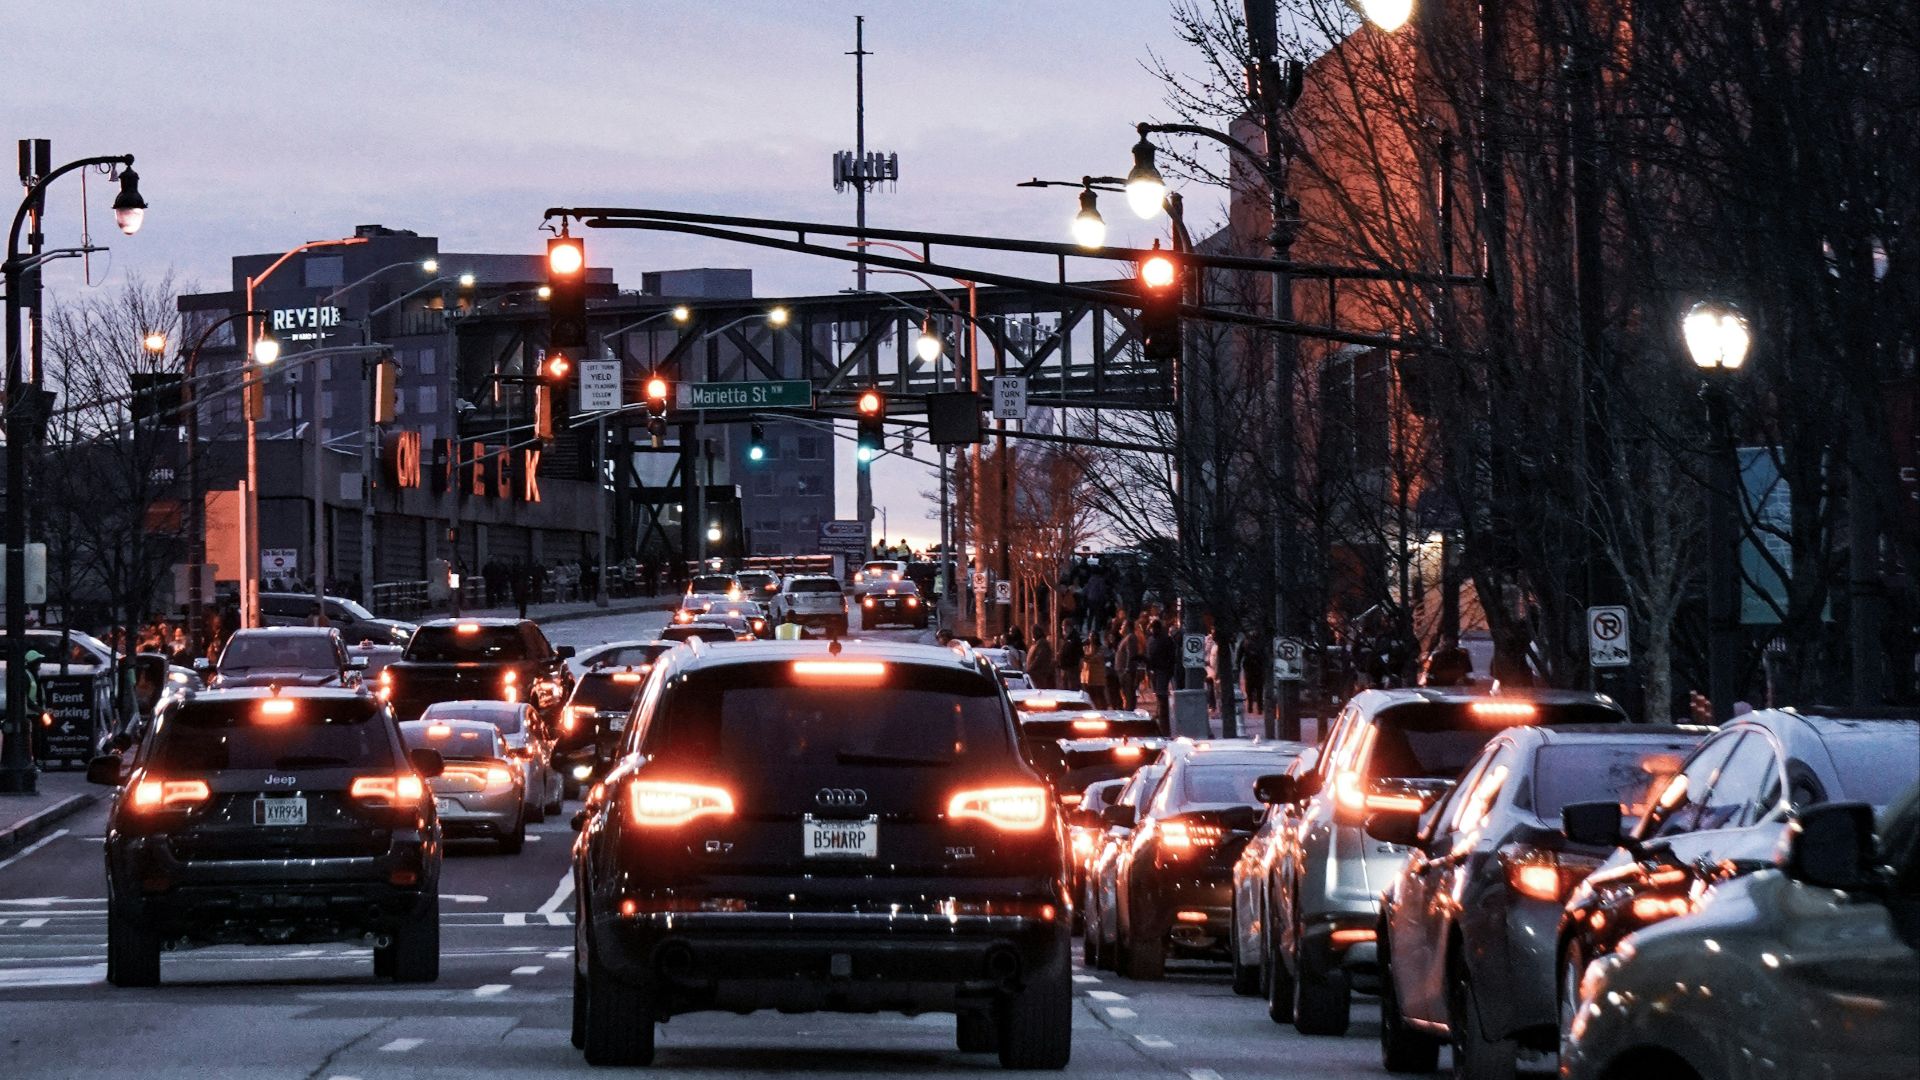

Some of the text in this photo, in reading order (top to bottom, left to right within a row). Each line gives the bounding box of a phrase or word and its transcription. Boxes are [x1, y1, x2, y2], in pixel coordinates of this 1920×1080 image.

[1003, 380, 1018, 389] NO
[693, 385, 783, 404] Marietta St NW
[1005, 399, 1016, 407] ON
[52, 693, 84, 703] Event
[47, 707, 90, 720] Parking
[264, 774, 297, 786] Jeep
[268, 806, 303, 819] XYR934
[814, 830, 866, 849] B5HARP
